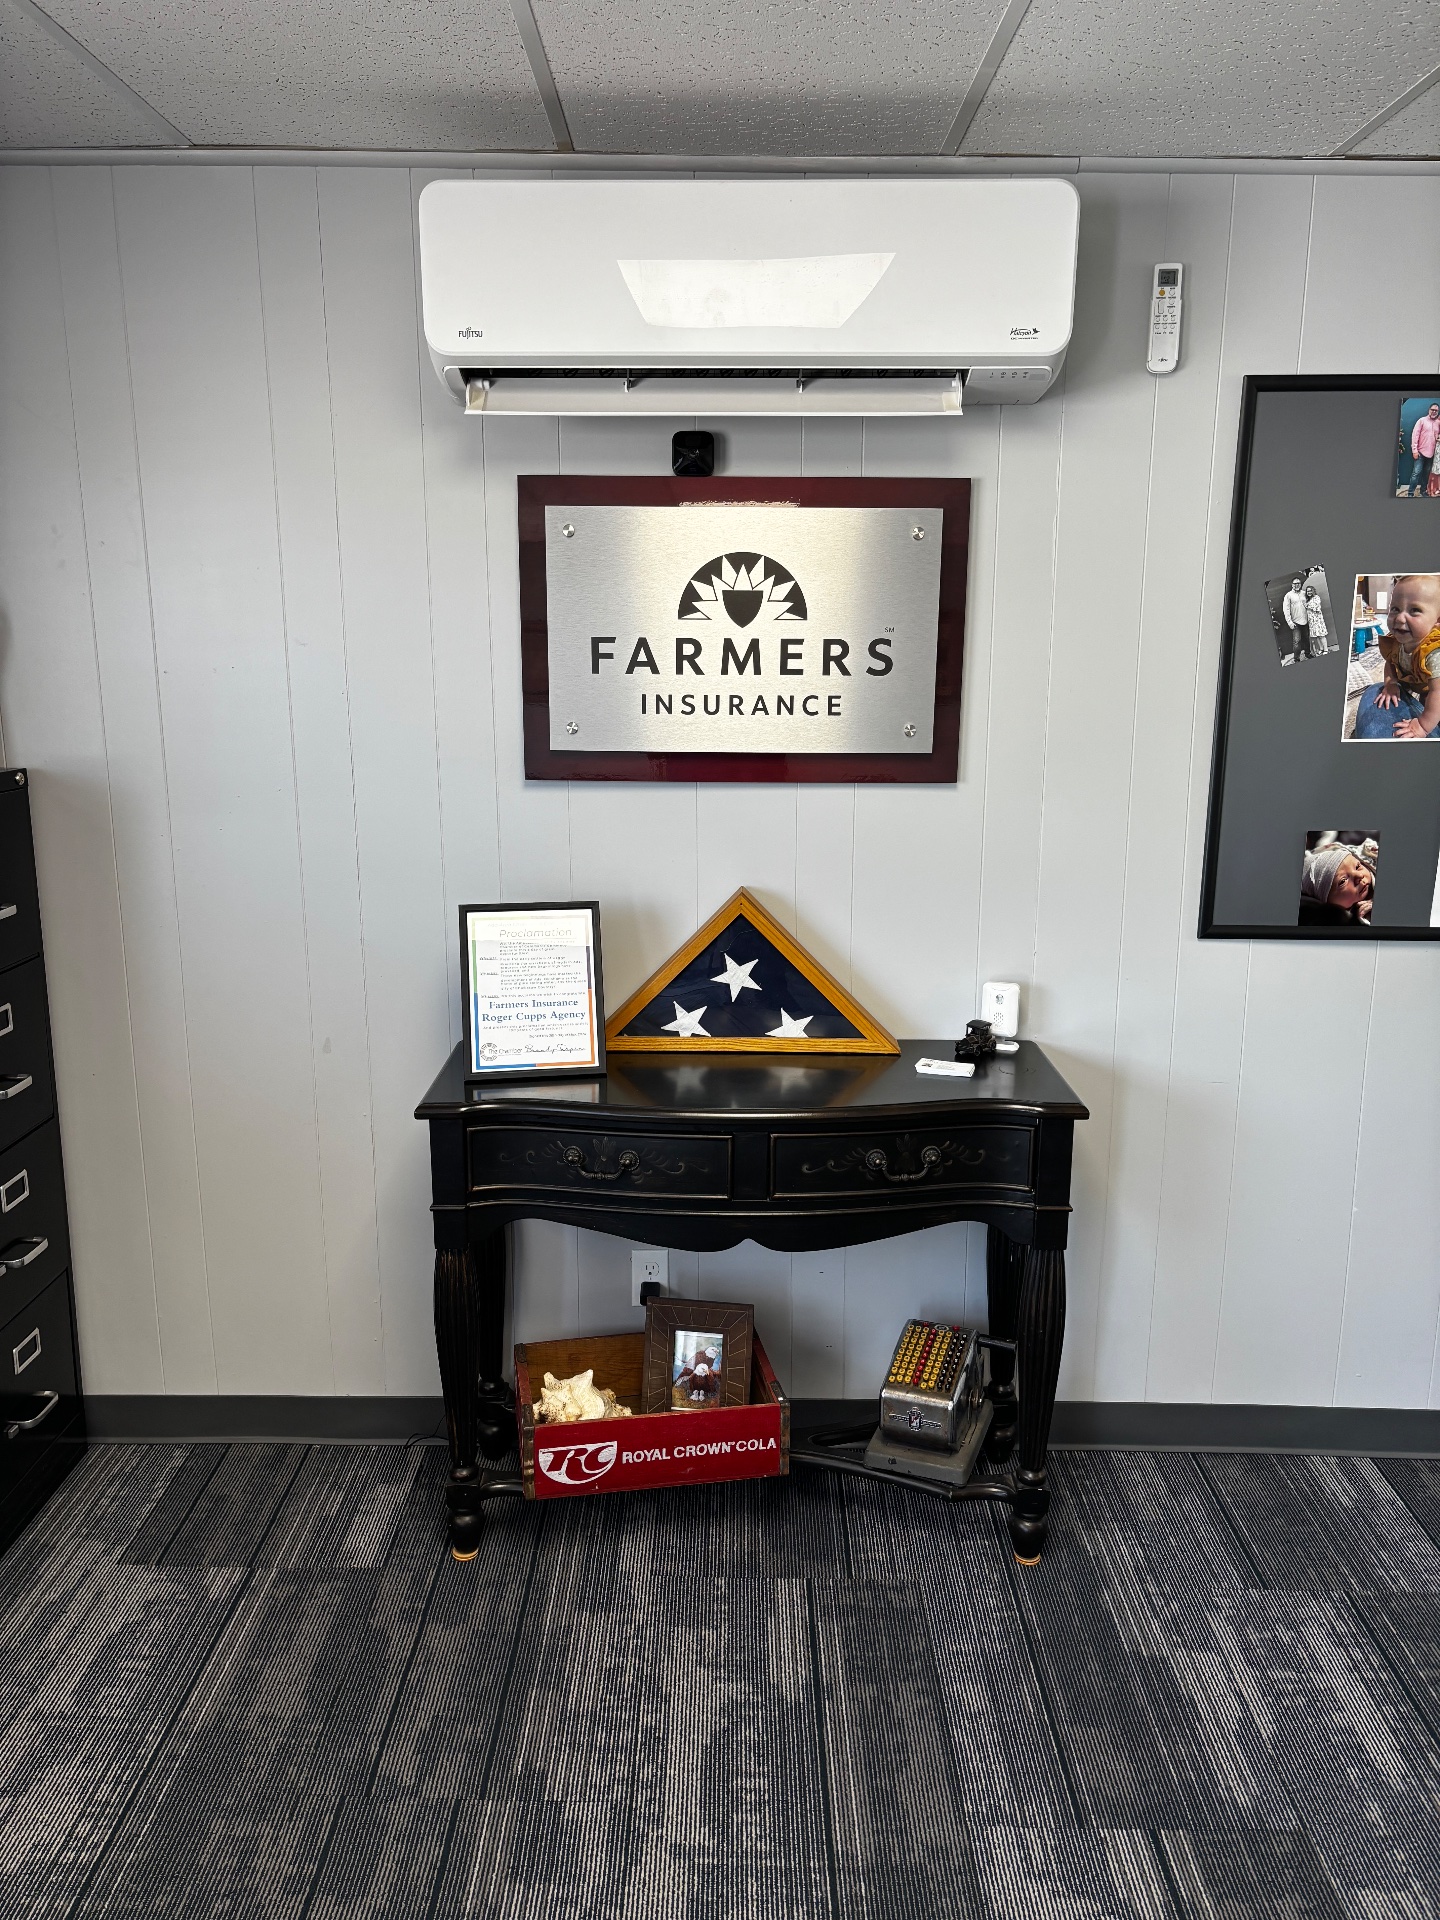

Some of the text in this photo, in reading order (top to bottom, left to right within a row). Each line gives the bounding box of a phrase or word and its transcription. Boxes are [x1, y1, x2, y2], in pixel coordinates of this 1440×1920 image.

[458, 326, 483, 340] FUJITSU
[591, 637, 894, 676] FARMERS
[641, 694, 842, 716] INSURANCE
[499, 928, 572, 938] Proclamation
[489, 999, 579, 1009] Farmers Insurance
[482, 1010, 586, 1023] Roger Cupps Agency
[622, 1448, 671, 1464] ROYAL
[735, 1437, 777, 1452] COLA
